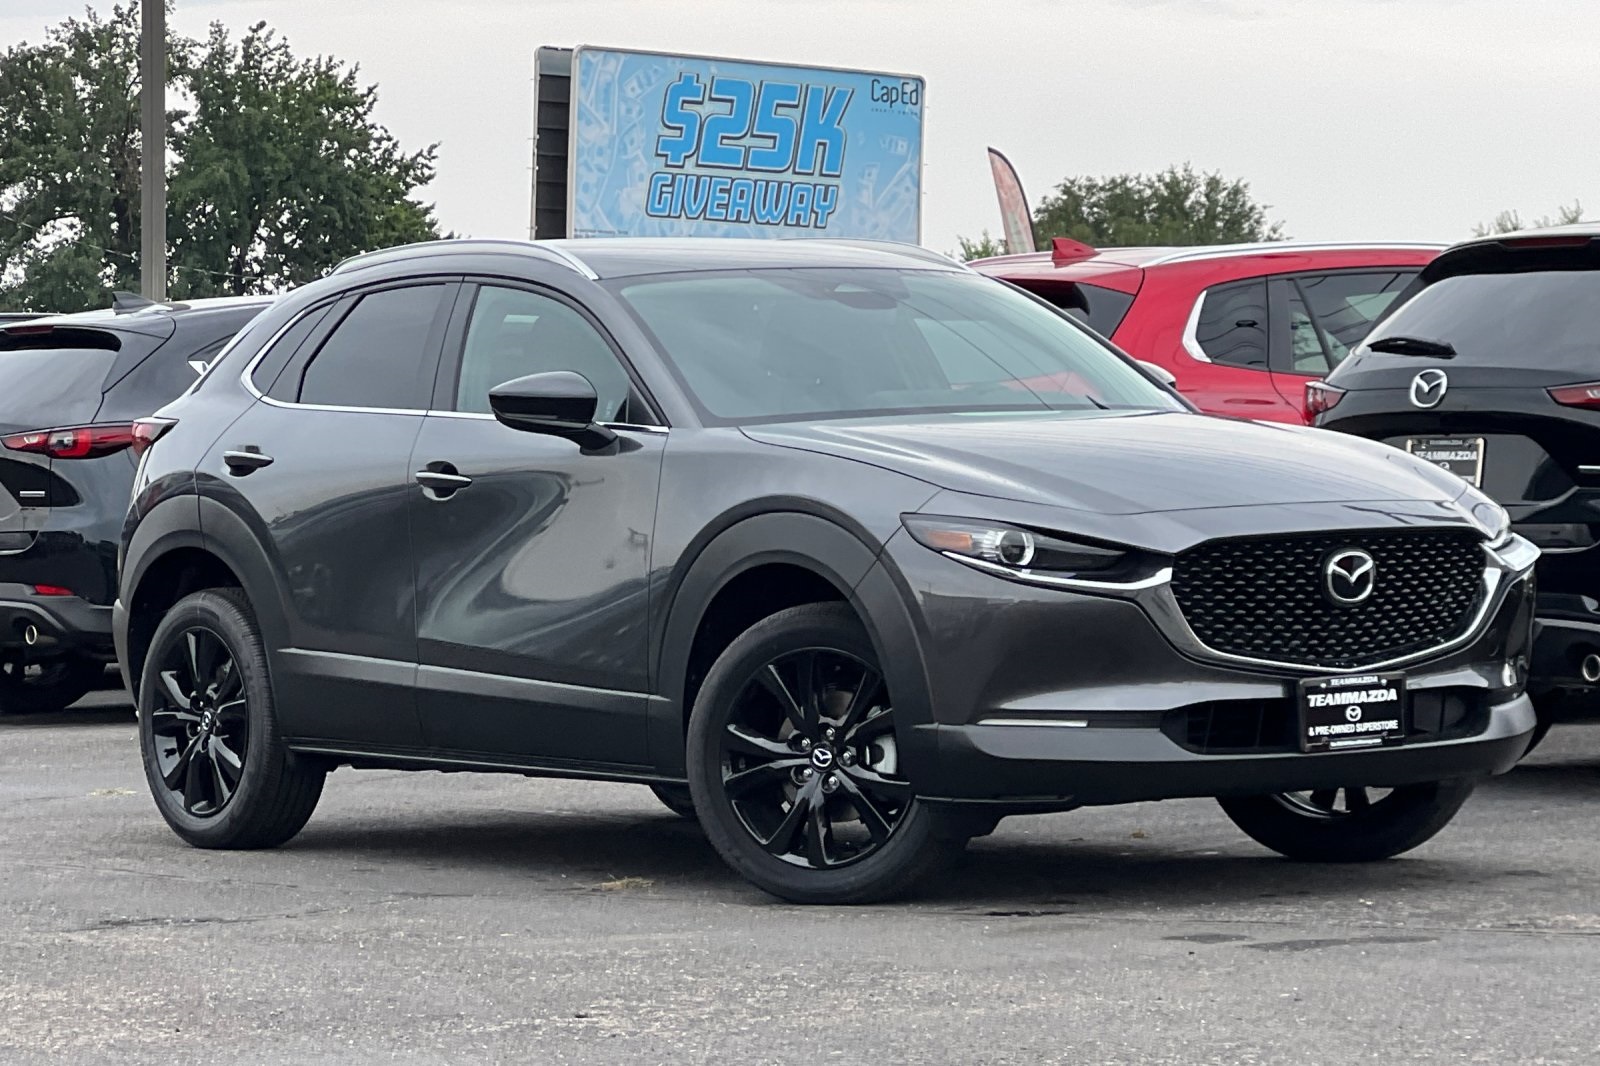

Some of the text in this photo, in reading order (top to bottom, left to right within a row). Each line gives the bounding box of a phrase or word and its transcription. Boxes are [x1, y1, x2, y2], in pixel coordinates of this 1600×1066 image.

[655, 72, 854, 178] $25K
[646, 171, 839, 229] GIVEAWAY
[1414, 451, 1477, 460] TEAMMAZDA
[1307, 688, 1398, 708] TEAMMAZDA
[1356, 720, 1399, 732] SUPERSTORE
